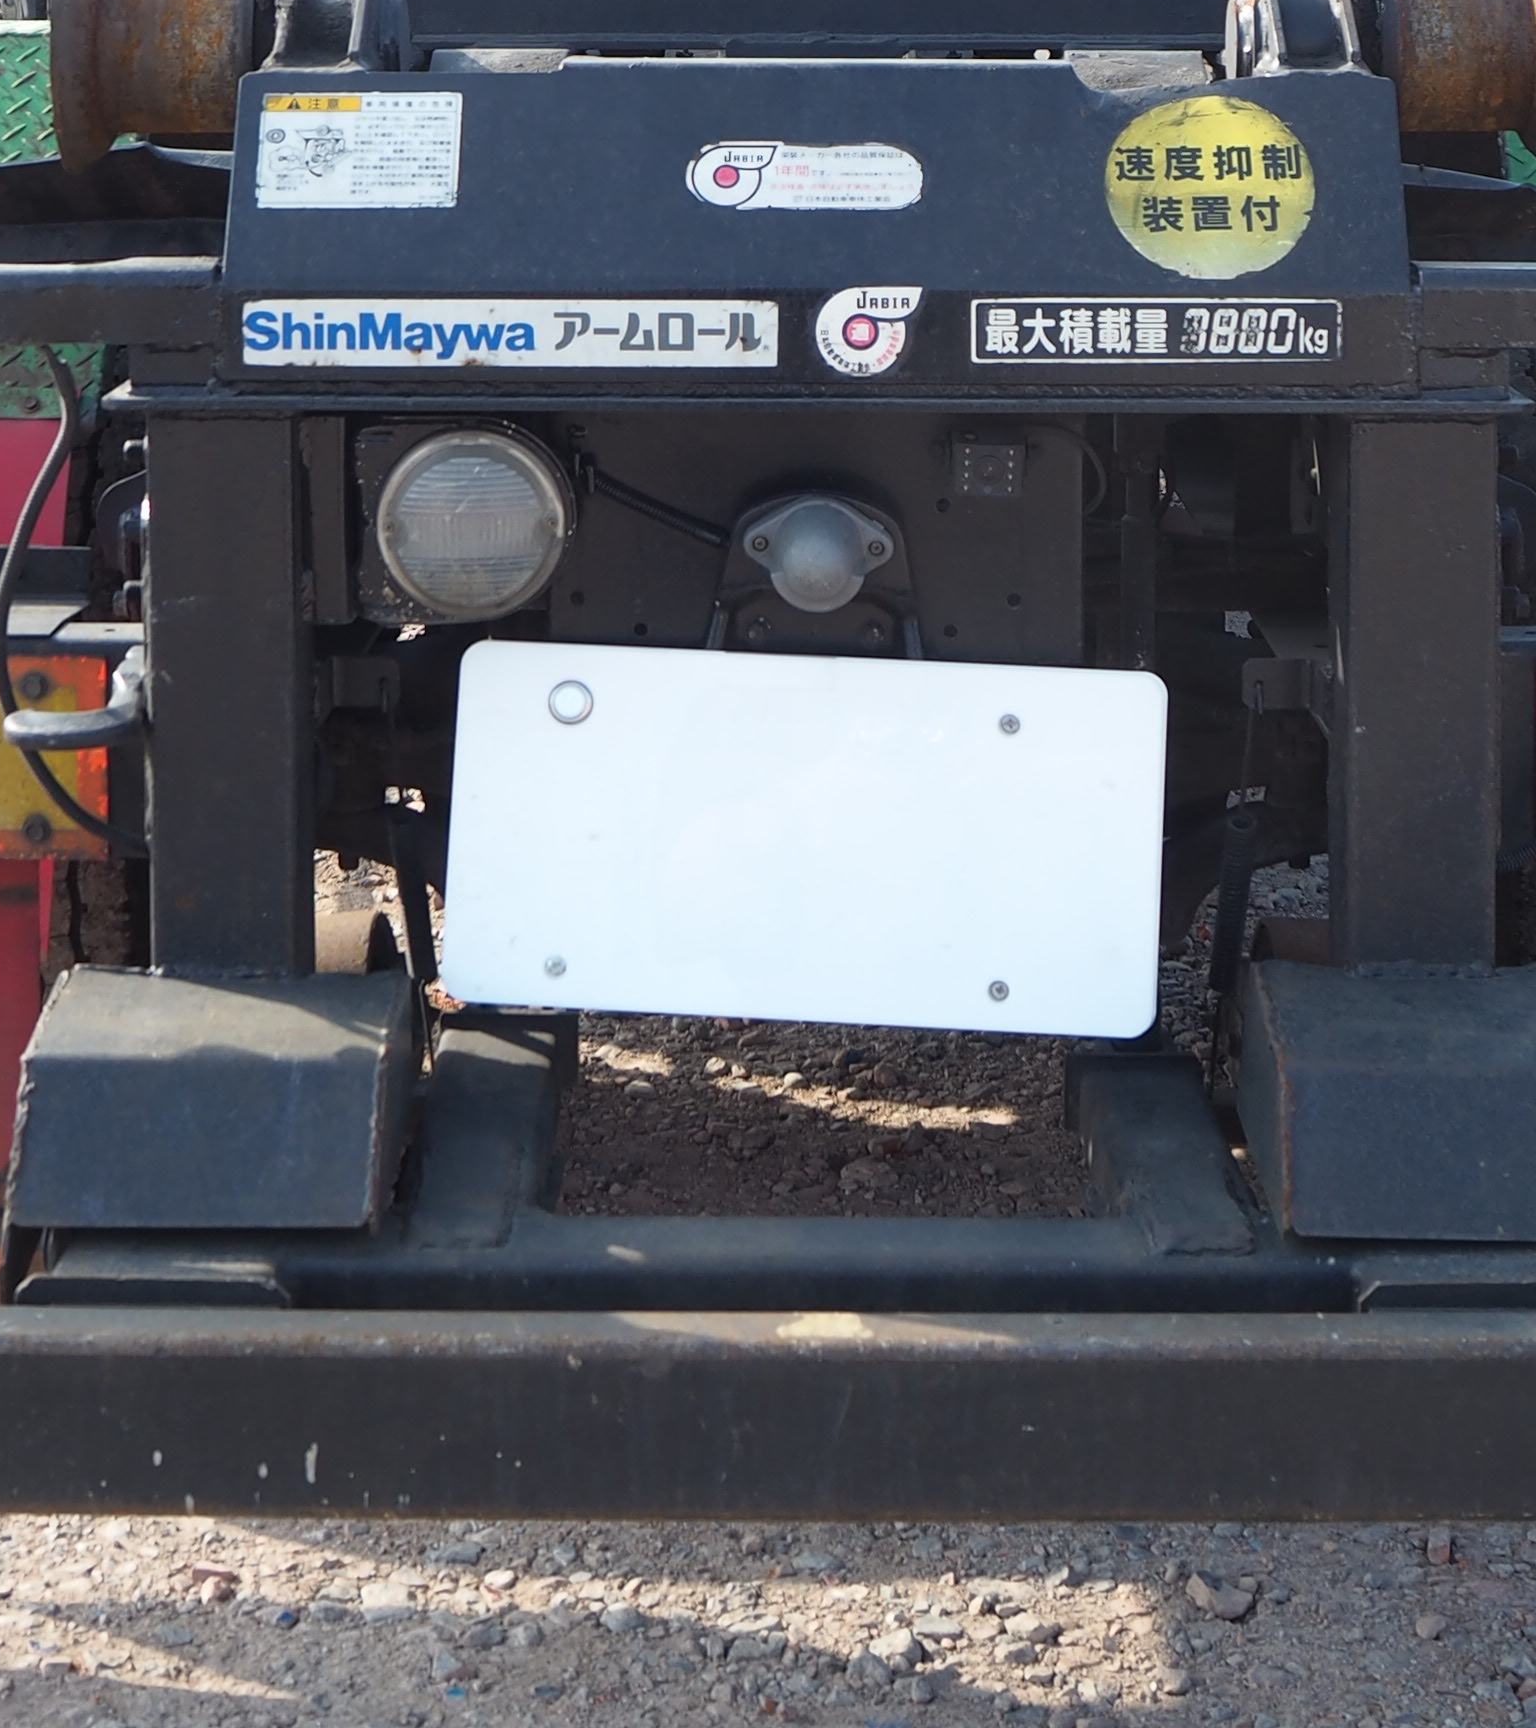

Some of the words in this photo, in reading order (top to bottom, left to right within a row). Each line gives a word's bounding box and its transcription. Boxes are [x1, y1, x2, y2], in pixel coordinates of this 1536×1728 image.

[724, 151, 764, 163] JABIA
[1114, 144, 1302, 182] 速度抑制
[1142, 195, 1281, 233] 装置付
[857, 291, 910, 309] JABIA
[244, 312, 536, 360] ShinMaywa
[553, 312, 762, 352] アームロール
[985, 308, 1169, 355] 最大積載量
